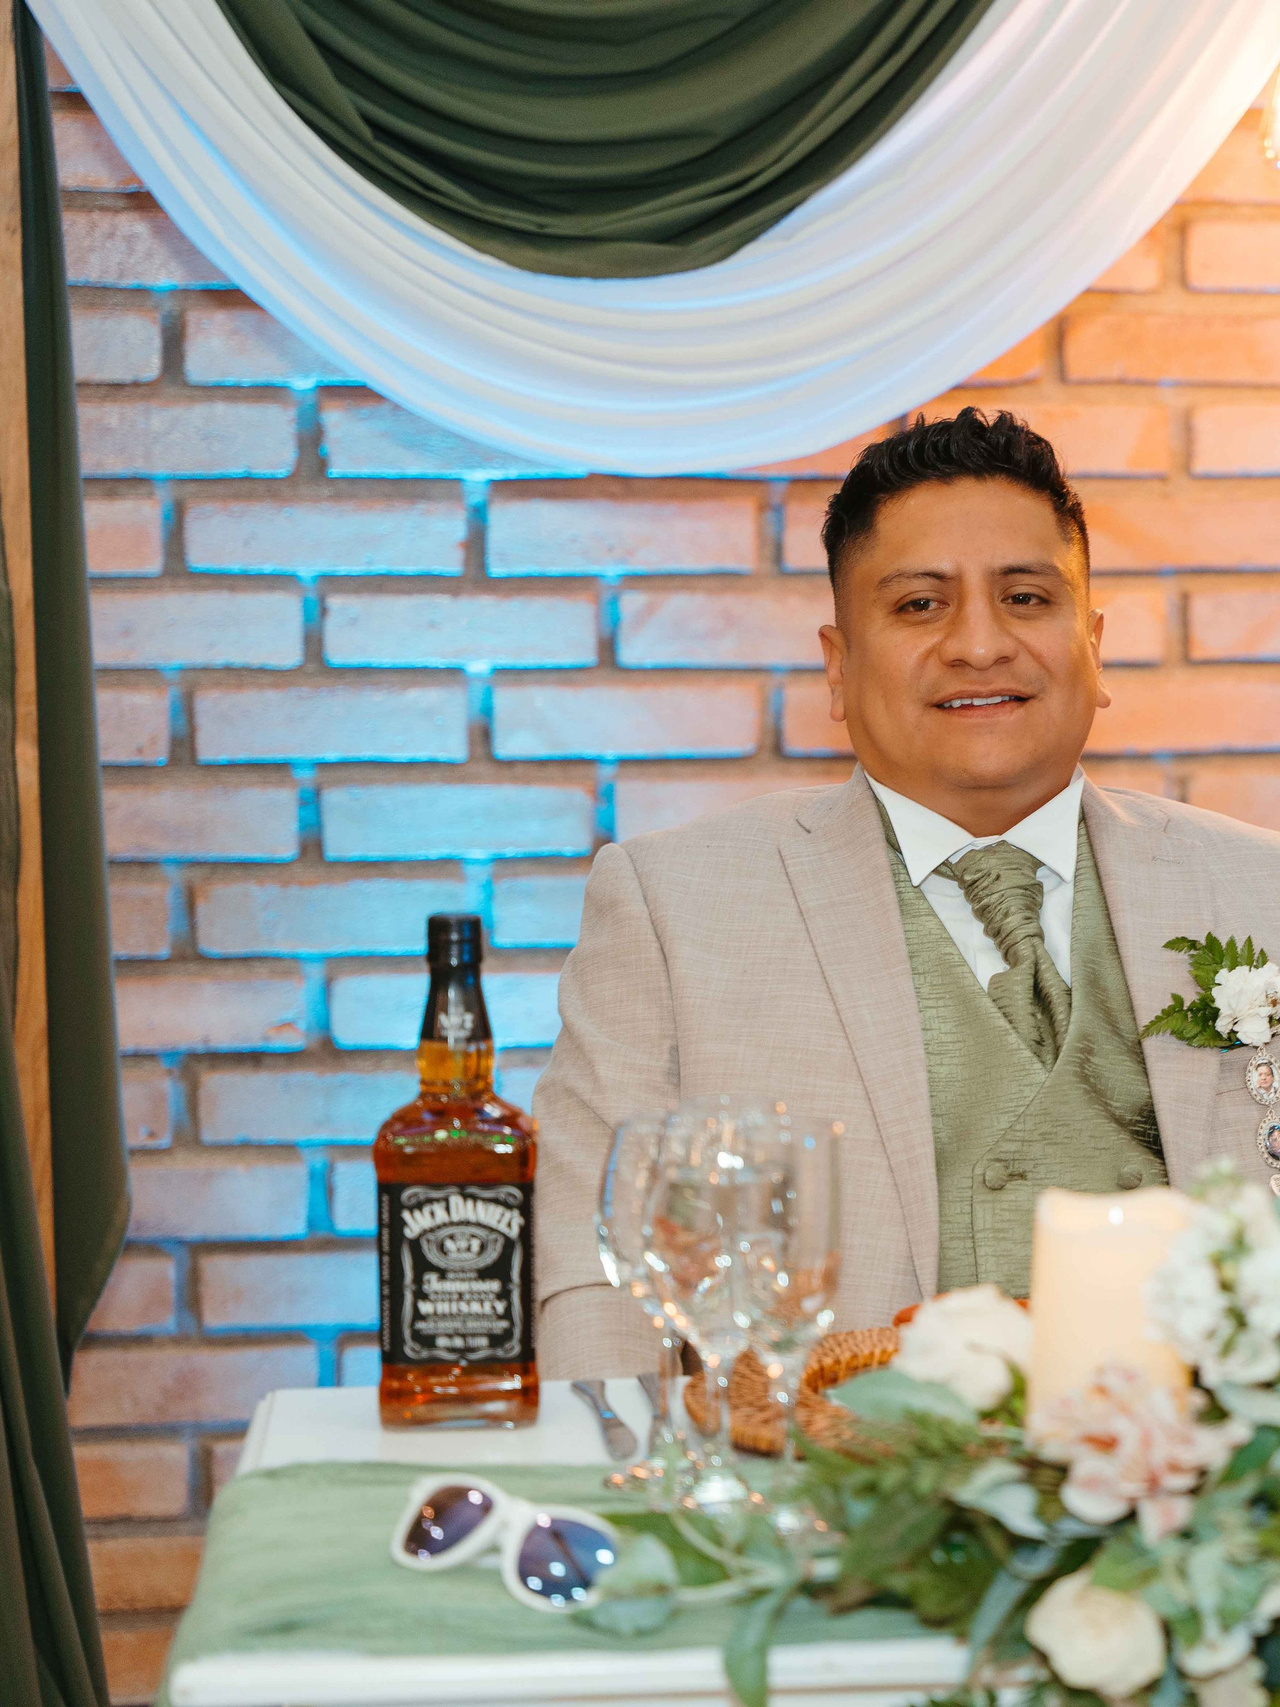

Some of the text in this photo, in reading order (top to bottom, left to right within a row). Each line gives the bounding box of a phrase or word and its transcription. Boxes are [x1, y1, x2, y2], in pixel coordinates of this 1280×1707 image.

[401, 1193, 525, 1240] JACK DANIEL'S
[416, 1299, 508, 1316] WHISKEY
